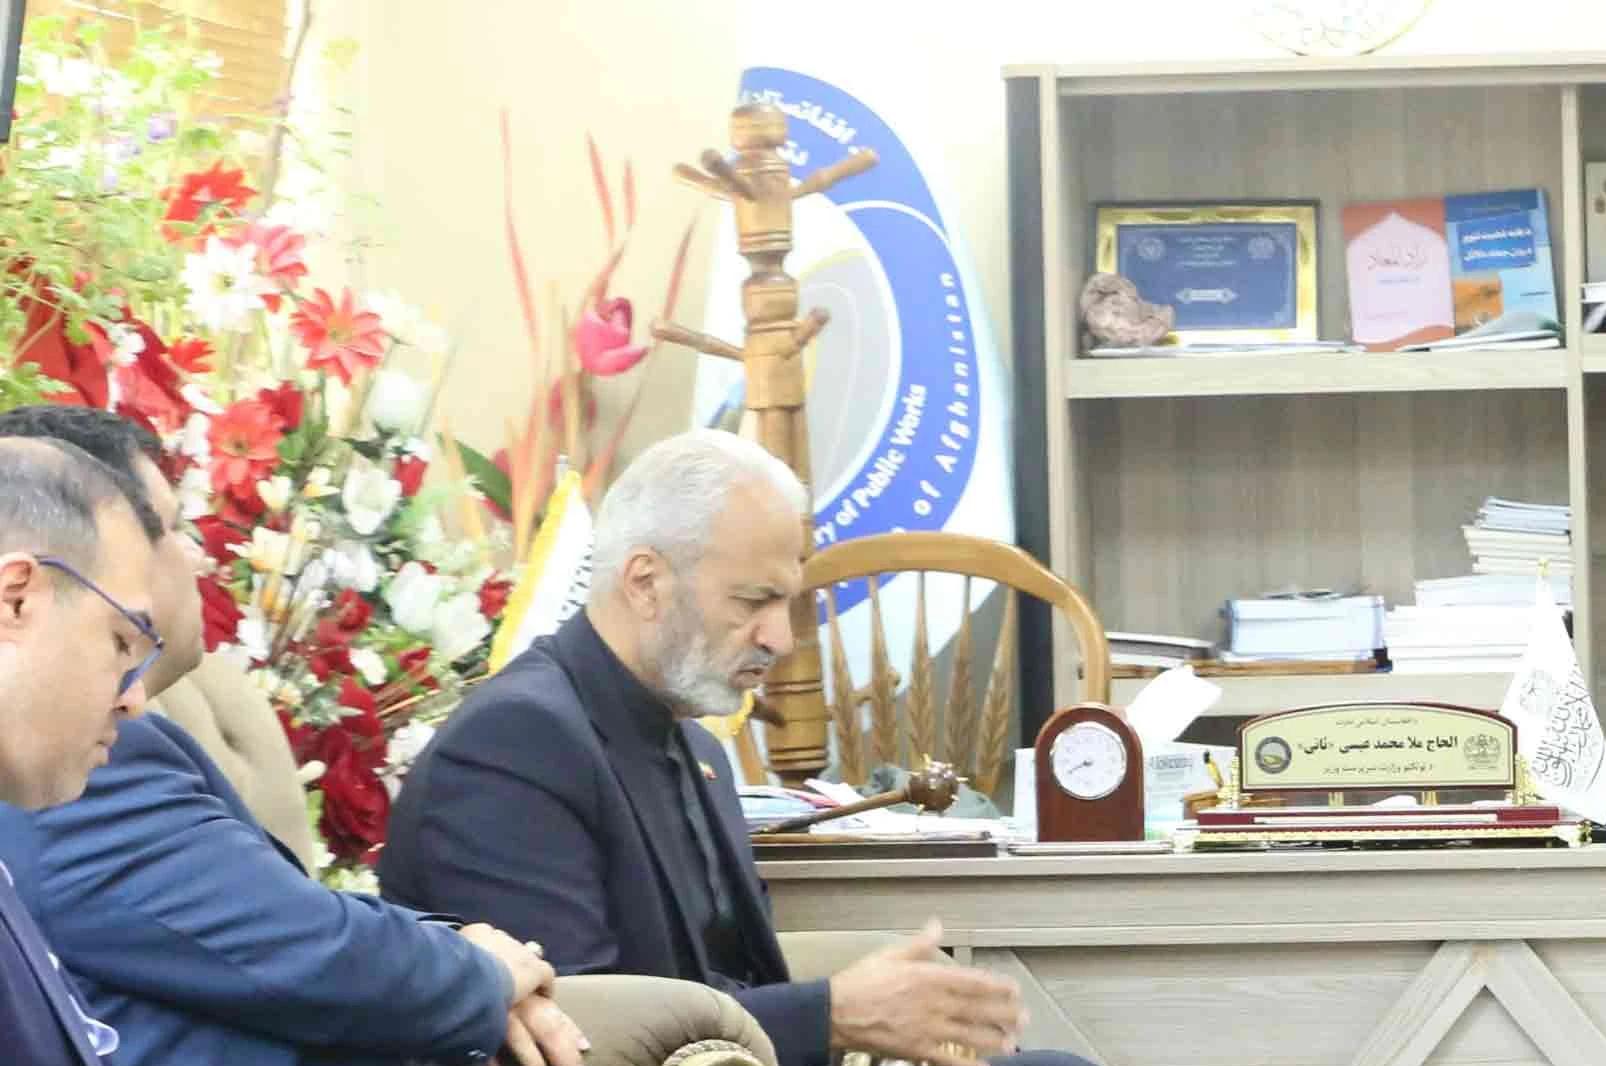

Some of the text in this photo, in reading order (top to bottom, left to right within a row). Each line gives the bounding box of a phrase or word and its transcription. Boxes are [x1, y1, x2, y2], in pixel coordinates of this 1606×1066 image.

[913, 272, 971, 516] of Afghanistan
[835, 384, 927, 526] of Public Works
[1374, 738, 1405, 749] محمد
[1408, 735, 1423, 749] ملا
[1426, 735, 1458, 752] الحاج
